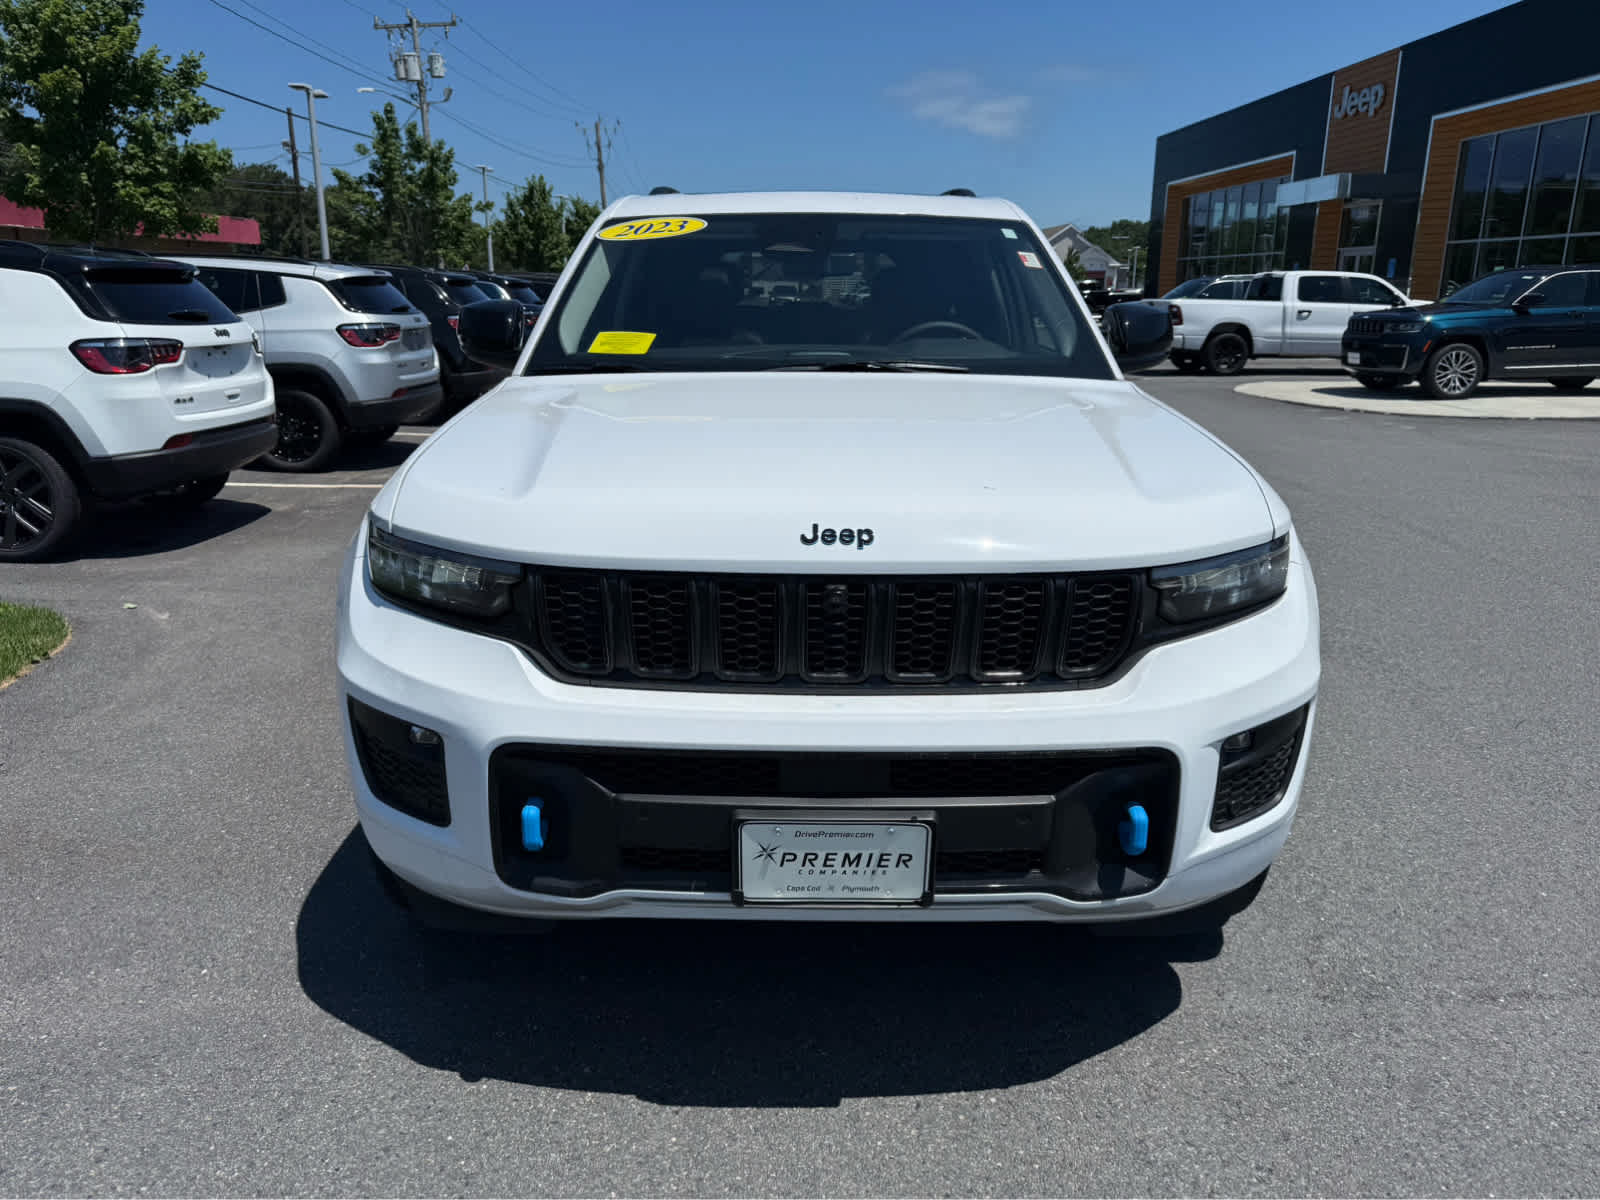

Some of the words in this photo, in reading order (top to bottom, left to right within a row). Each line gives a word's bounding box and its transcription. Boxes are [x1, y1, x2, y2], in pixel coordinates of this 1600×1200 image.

[1334, 83, 1384, 118] Jeep
[616, 220, 689, 237] 2023
[800, 523, 874, 550] Jeep
[779, 852, 913, 869] PREMIER
